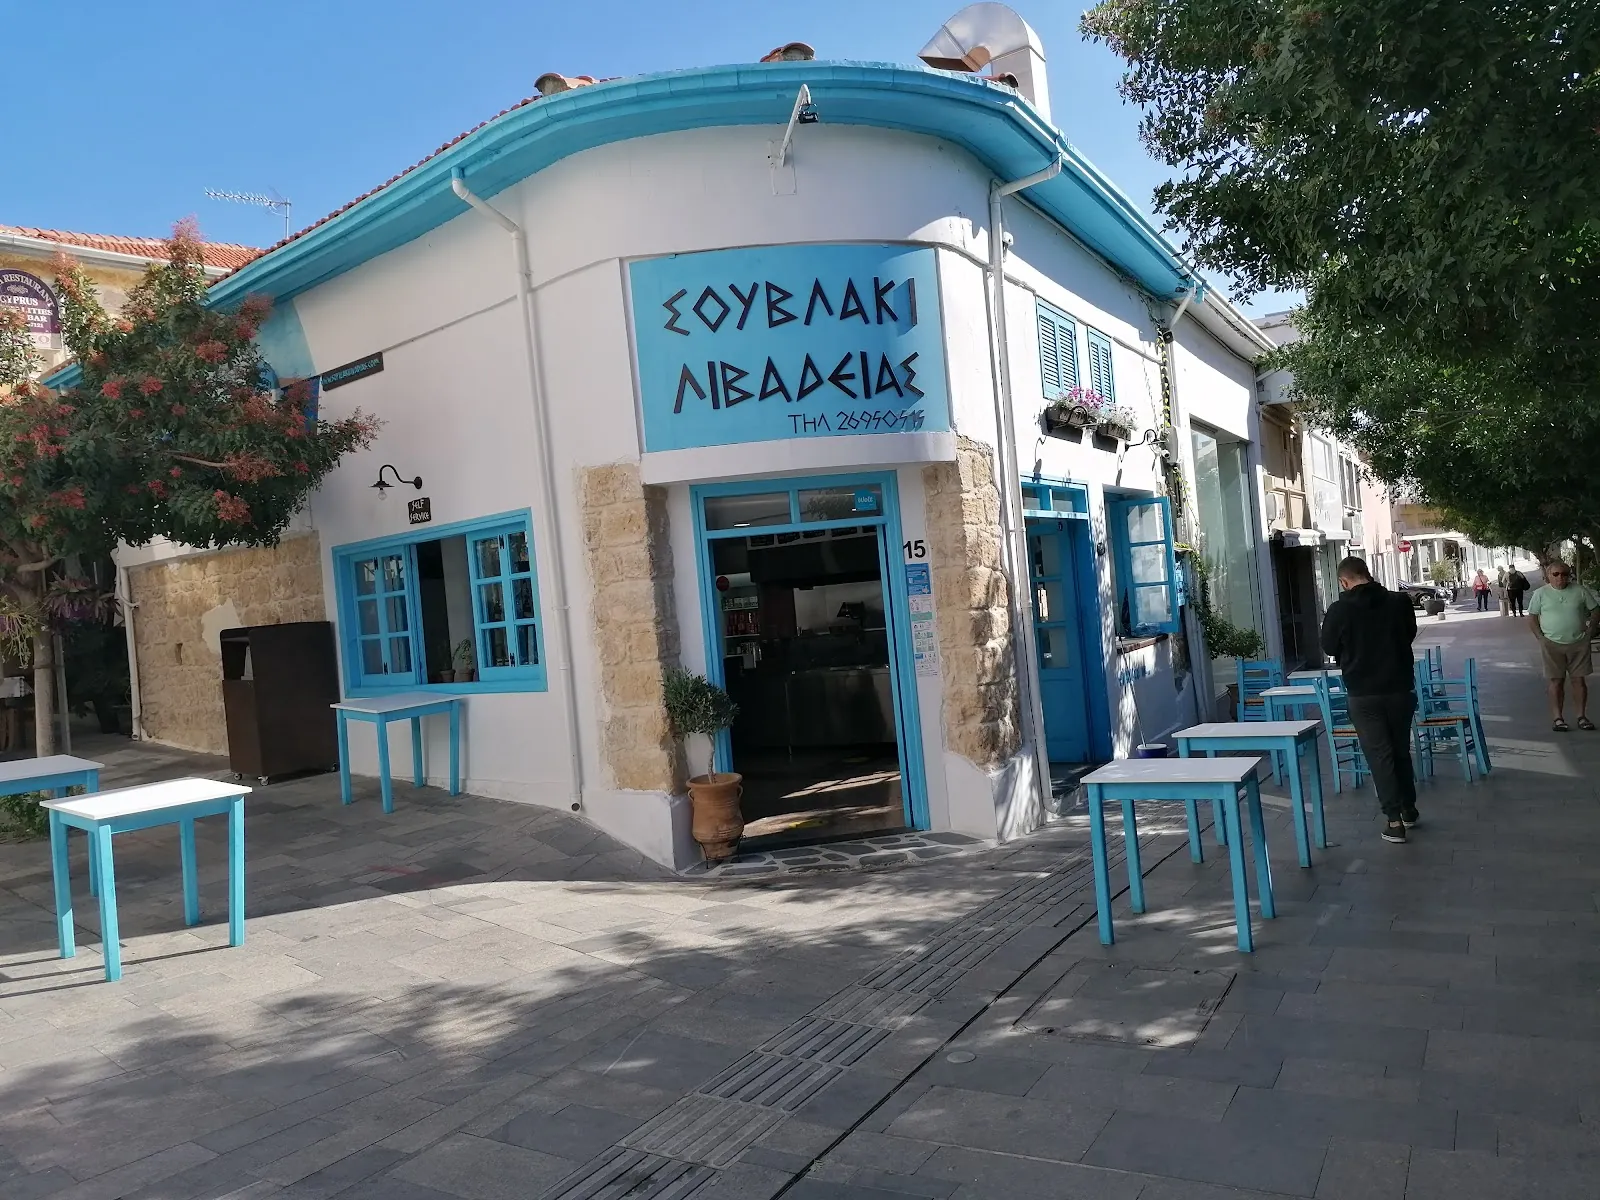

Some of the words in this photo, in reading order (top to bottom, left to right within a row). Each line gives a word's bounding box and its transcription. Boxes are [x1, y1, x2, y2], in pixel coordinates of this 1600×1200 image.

[2, 274, 55, 308] RESTAURANT
[662, 276, 918, 336] ΣΟΥΒΛΑΚΙ
[673, 351, 925, 414] ΛΙΒΑΔΕΙΑΣ
[788, 413, 831, 433] ΤΗΛ
[412, 500, 424, 511] SELF
[410, 512, 429, 522] SERVICE
[903, 540, 926, 559] 15
